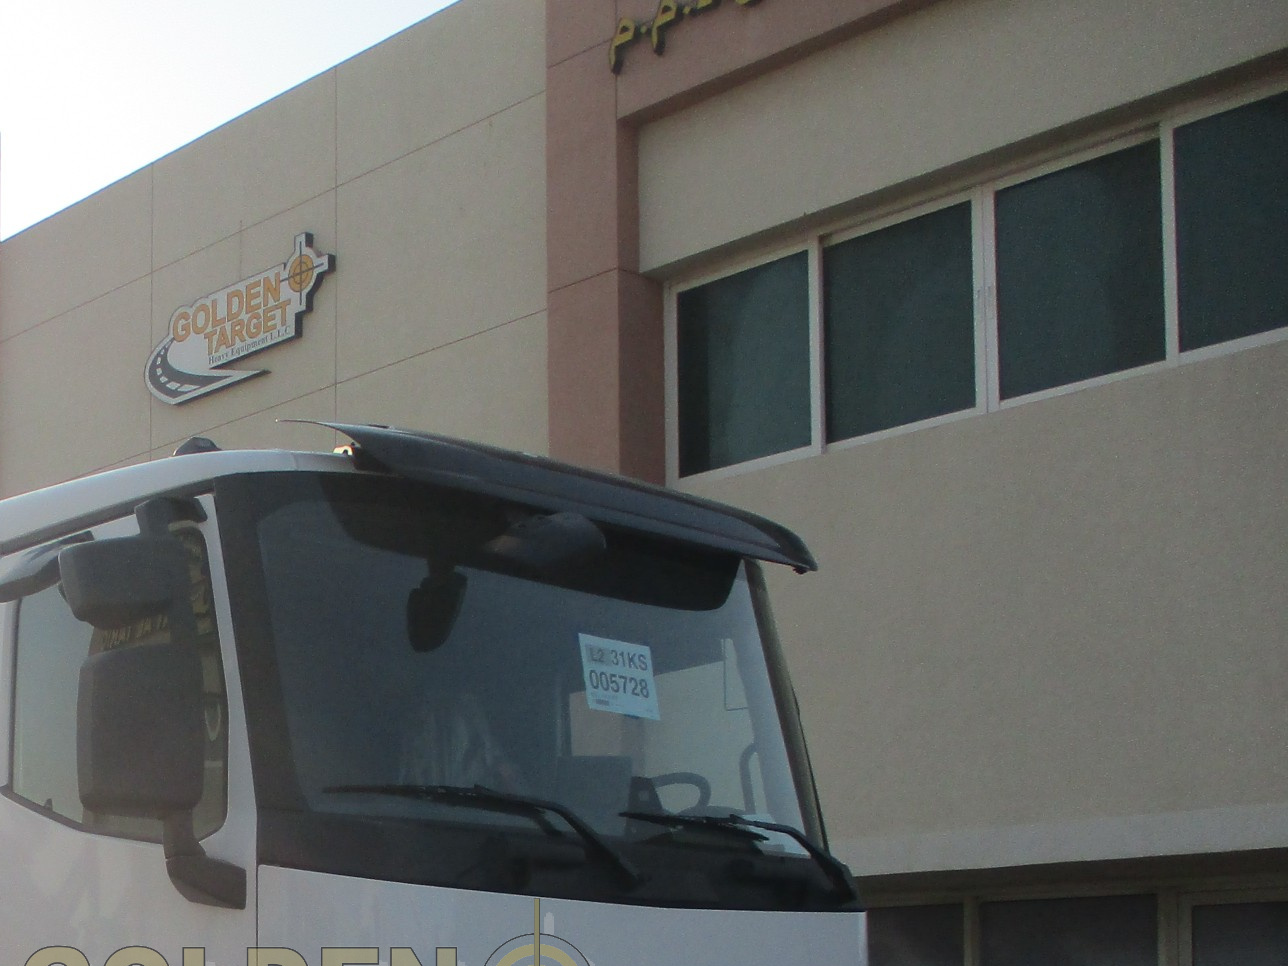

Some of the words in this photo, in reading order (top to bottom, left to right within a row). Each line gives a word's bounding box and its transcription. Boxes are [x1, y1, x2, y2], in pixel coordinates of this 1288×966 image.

[172, 271, 281, 342] GOLDEN
[203, 299, 291, 355] TARGET
[231, 336, 268, 356] Equipment
[610, 649, 648, 671] 31KS
[589, 669, 650, 699] 005728
